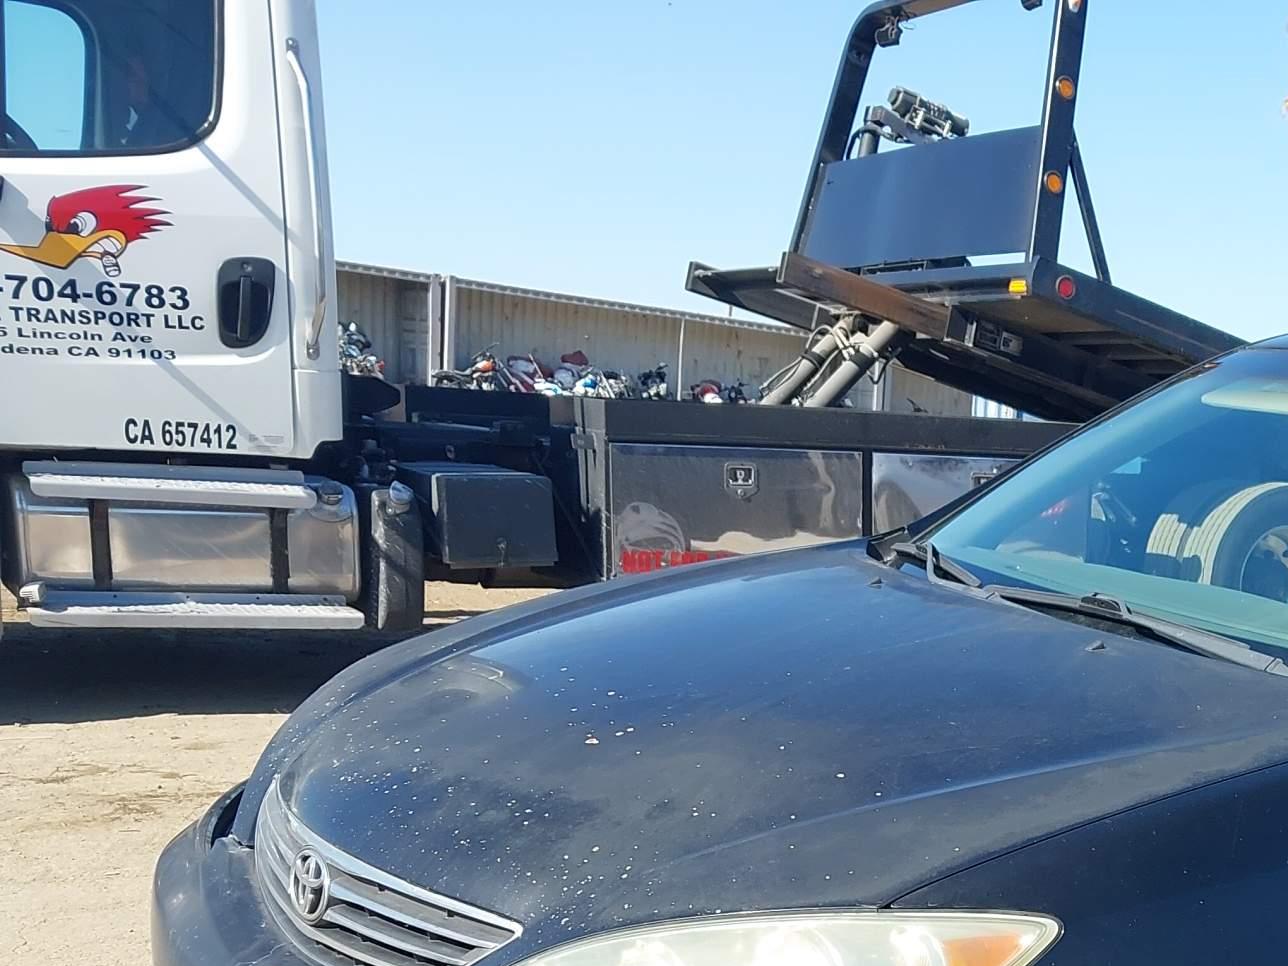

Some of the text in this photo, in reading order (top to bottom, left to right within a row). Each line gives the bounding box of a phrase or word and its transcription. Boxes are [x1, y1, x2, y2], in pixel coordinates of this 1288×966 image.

[9, 306, 205, 330] TRANSPORT LLC
[17, 325, 102, 342] Lincoln
[112, 331, 153, 343] Ave
[68, 346, 100, 357] CA
[108, 347, 176, 360] 91103
[124, 418, 154, 445] CA
[161, 421, 237, 449] 657412
